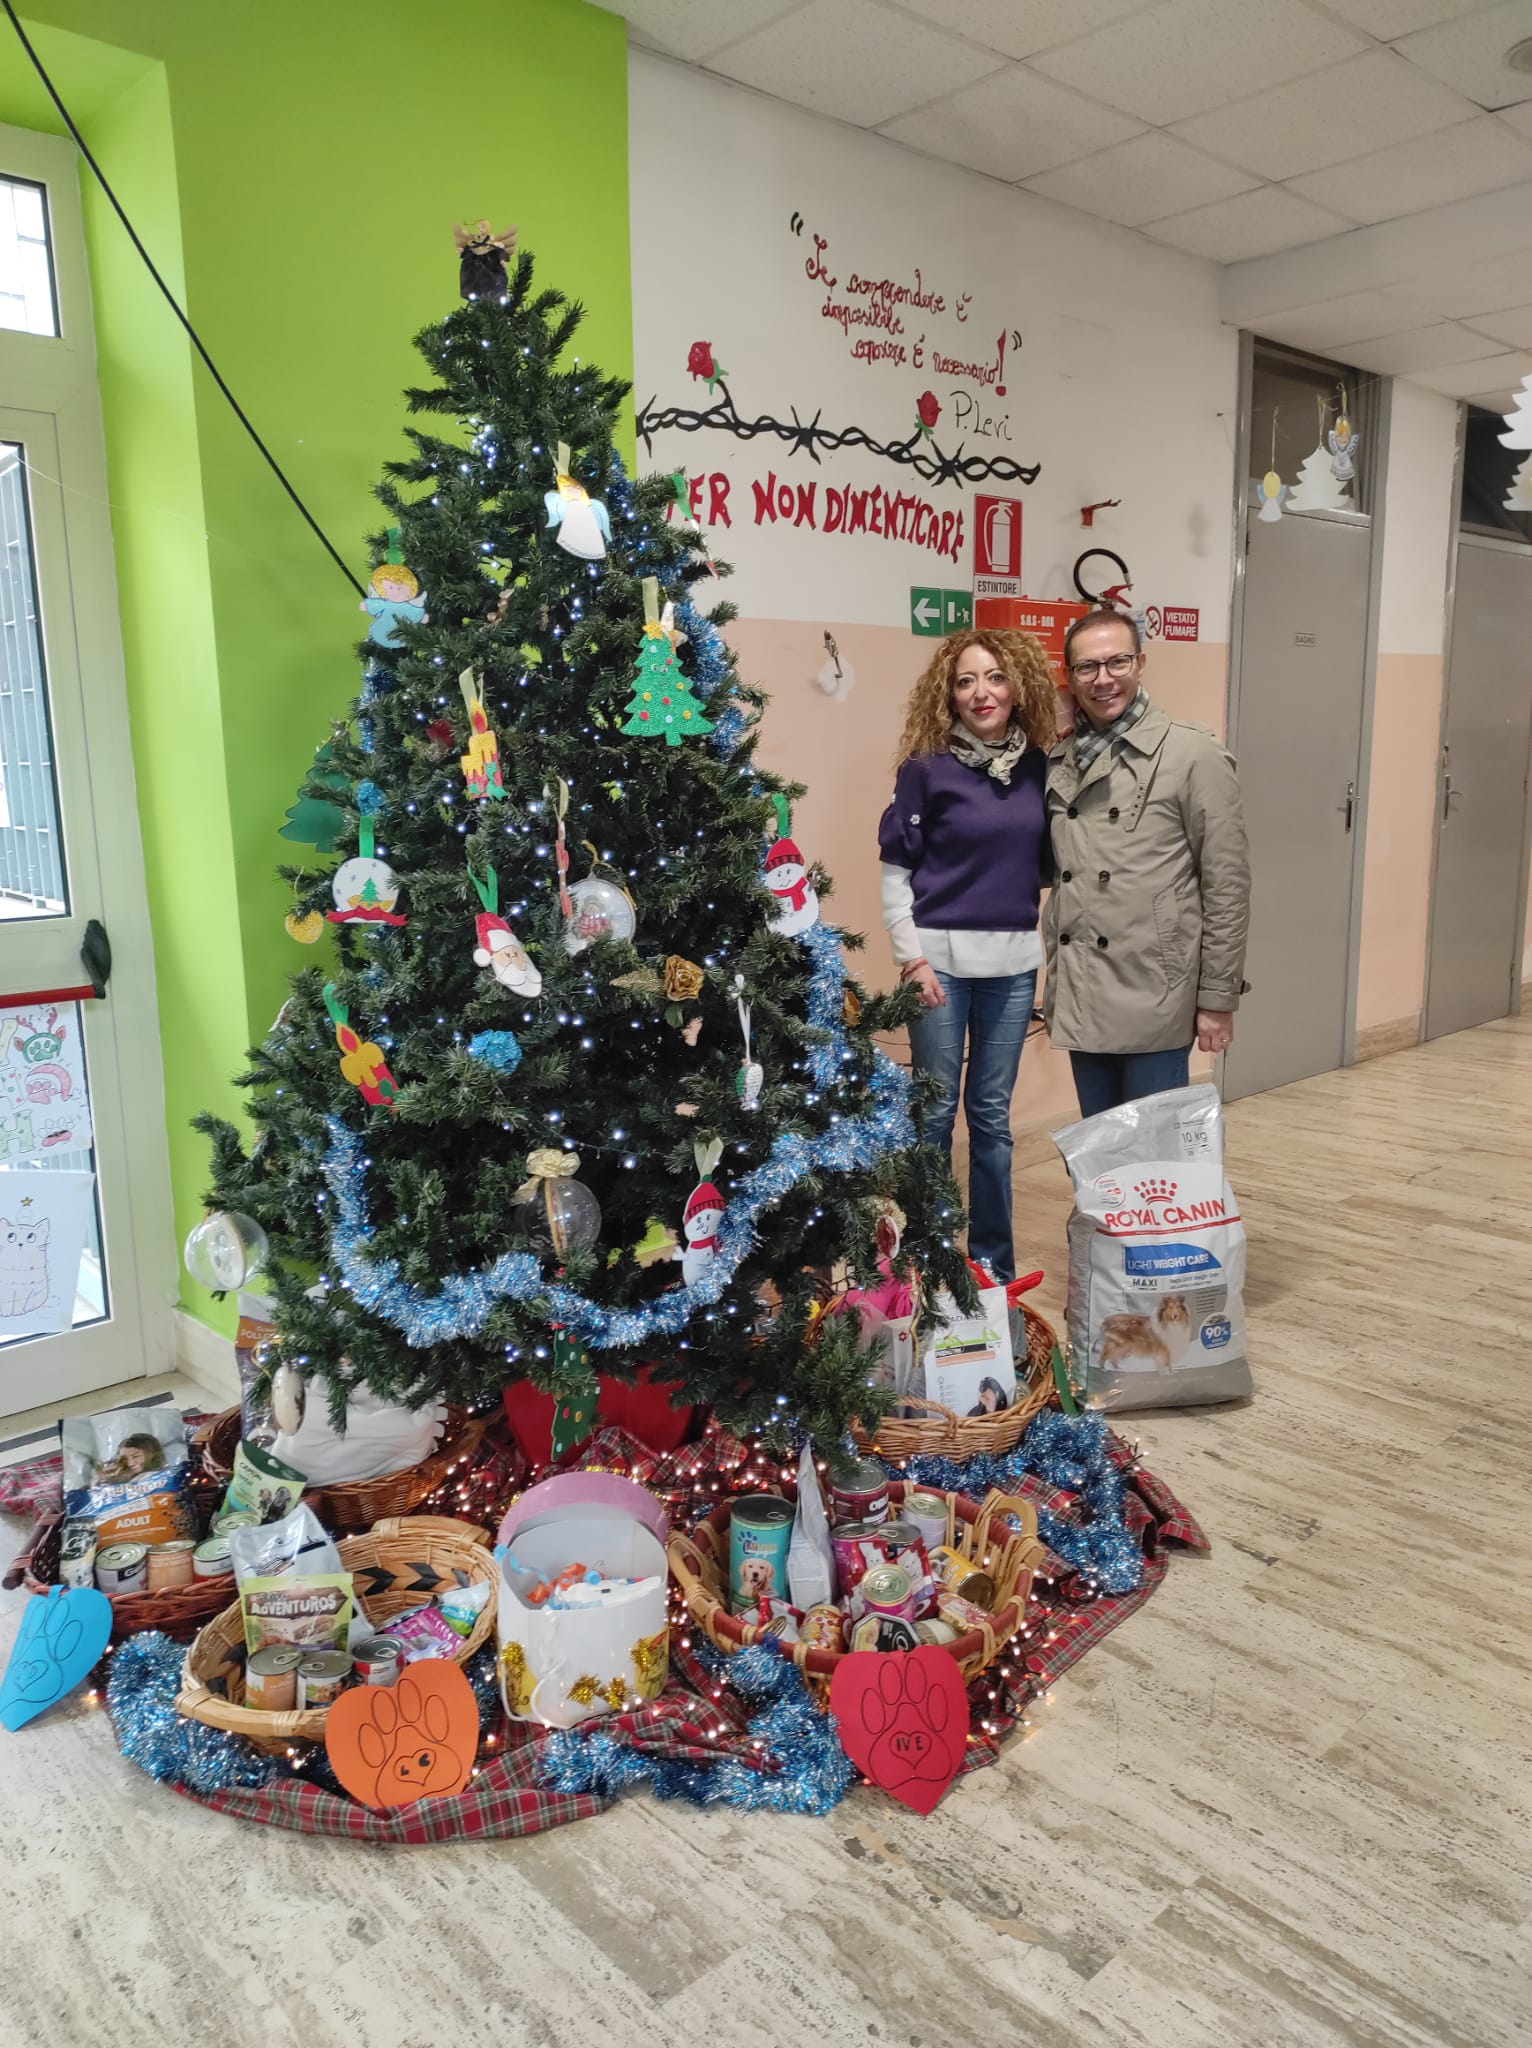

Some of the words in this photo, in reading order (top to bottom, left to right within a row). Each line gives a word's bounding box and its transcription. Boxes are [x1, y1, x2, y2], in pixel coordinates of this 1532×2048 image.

[664, 472, 733, 529] ER
[751, 470, 817, 531] NON
[822, 482, 965, 565] DIMENTICARE
[977, 580, 1017, 595] ESTINTORE
[1166, 611, 1197, 624] VIETATO
[1165, 626, 1197, 638] FUMARE
[1181, 1131, 1193, 1144] 10
[1104, 1208, 1161, 1229] ROYAL
[1163, 1198, 1226, 1225] CANIN
[1187, 1253, 1209, 1266] CARE
[1132, 1278, 1158, 1287] MAXI
[115, 1514, 152, 1530] ADULT
